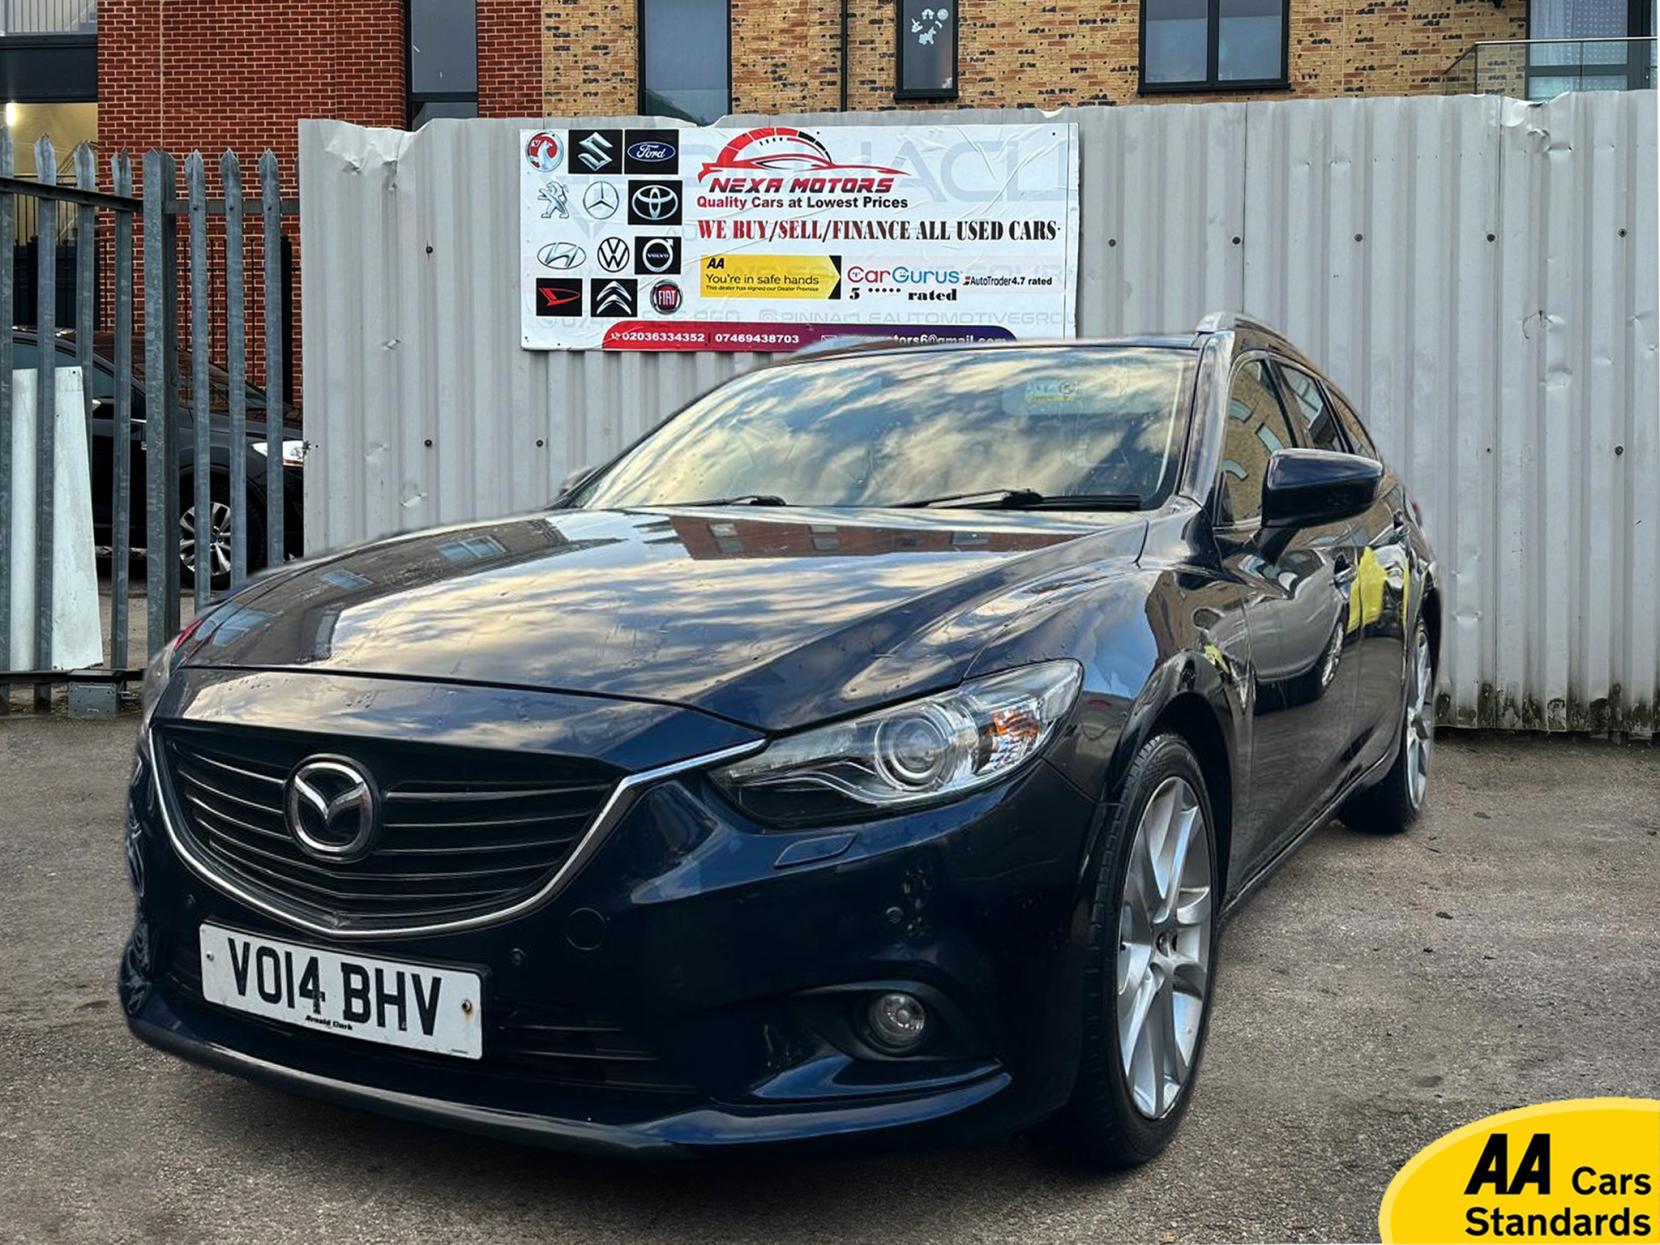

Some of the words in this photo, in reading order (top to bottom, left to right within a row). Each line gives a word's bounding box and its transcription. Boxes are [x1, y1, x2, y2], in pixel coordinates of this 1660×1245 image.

[636, 144, 666, 159] Ford
[709, 177, 784, 194] NEXA
[789, 177, 895, 194] MOTORS
[697, 196, 746, 210] Quality
[751, 196, 784, 209] Cars
[788, 197, 803, 209] at
[807, 196, 859, 209] Lowest
[863, 197, 909, 209] Prices
[697, 219, 727, 240] WE
[916, 220, 951, 241] ALL
[956, 220, 1004, 241] USED
[1008, 220, 1057, 241] CARS
[706, 257, 725, 269] AA
[705, 273, 742, 284] You're
[744, 274, 755, 284] in
[757, 273, 782, 285] safe
[784, 274, 820, 285] hands
[847, 266, 960, 284] CarGurus
[1011, 277, 1025, 286] 4.7
[1028, 277, 1053, 286] rated
[658, 289, 677, 306] FIAT
[849, 287, 860, 300] 5
[907, 288, 957, 301] rated
[622, 331, 706, 343] 02036334352
[714, 332, 800, 344] 07469438703
[227, 937, 326, 1015] VO14
[340, 961, 442, 1037] BHV
